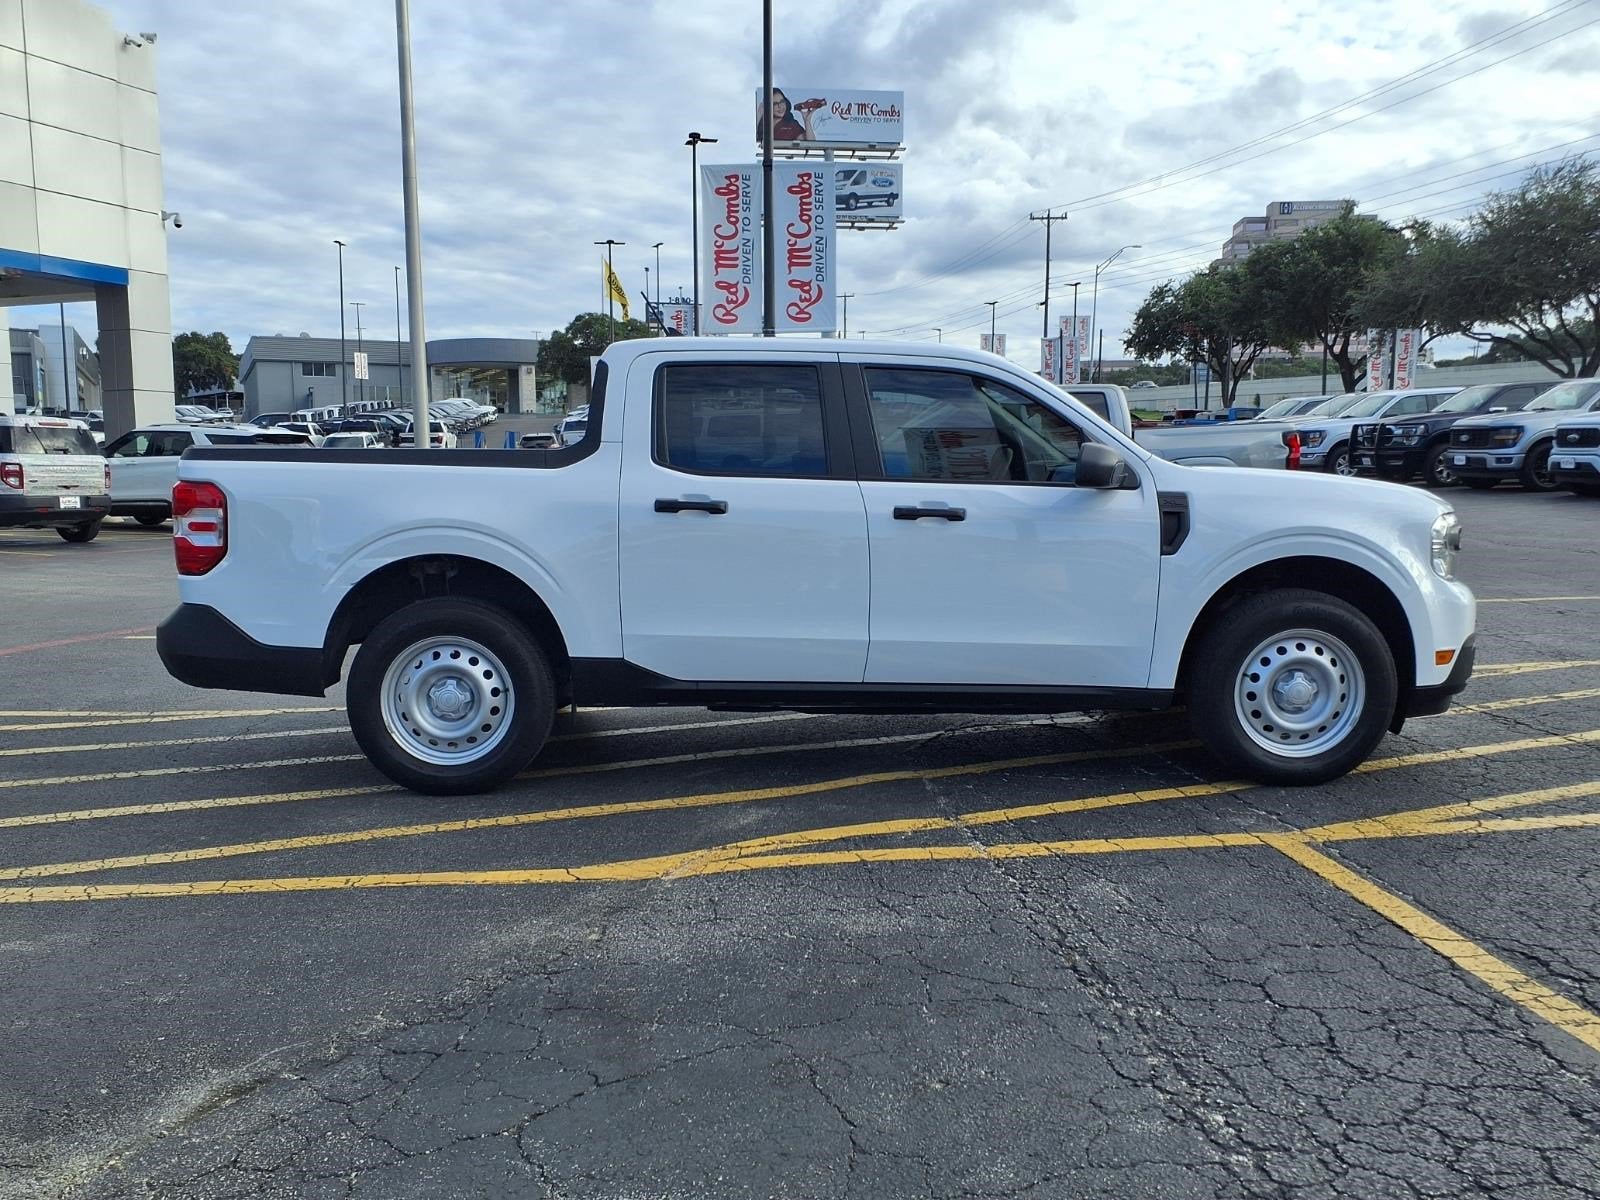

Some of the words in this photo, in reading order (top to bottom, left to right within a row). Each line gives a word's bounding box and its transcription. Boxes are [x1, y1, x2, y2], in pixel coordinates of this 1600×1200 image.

[831, 101, 852, 120] Red
[853, 103, 900, 117] McCombs
[742, 173, 751, 213] SERVE
[814, 172, 823, 211] SERVE
[714, 174, 739, 276] McCombs
[742, 216, 751, 233] TO
[786, 172, 812, 275] McCombs
[814, 214, 824, 231] TO
[742, 238, 751, 284] DRIVEN
[815, 235, 824, 282] DRIVEN
[713, 280, 750, 324] Red
[786, 279, 823, 323] Red
